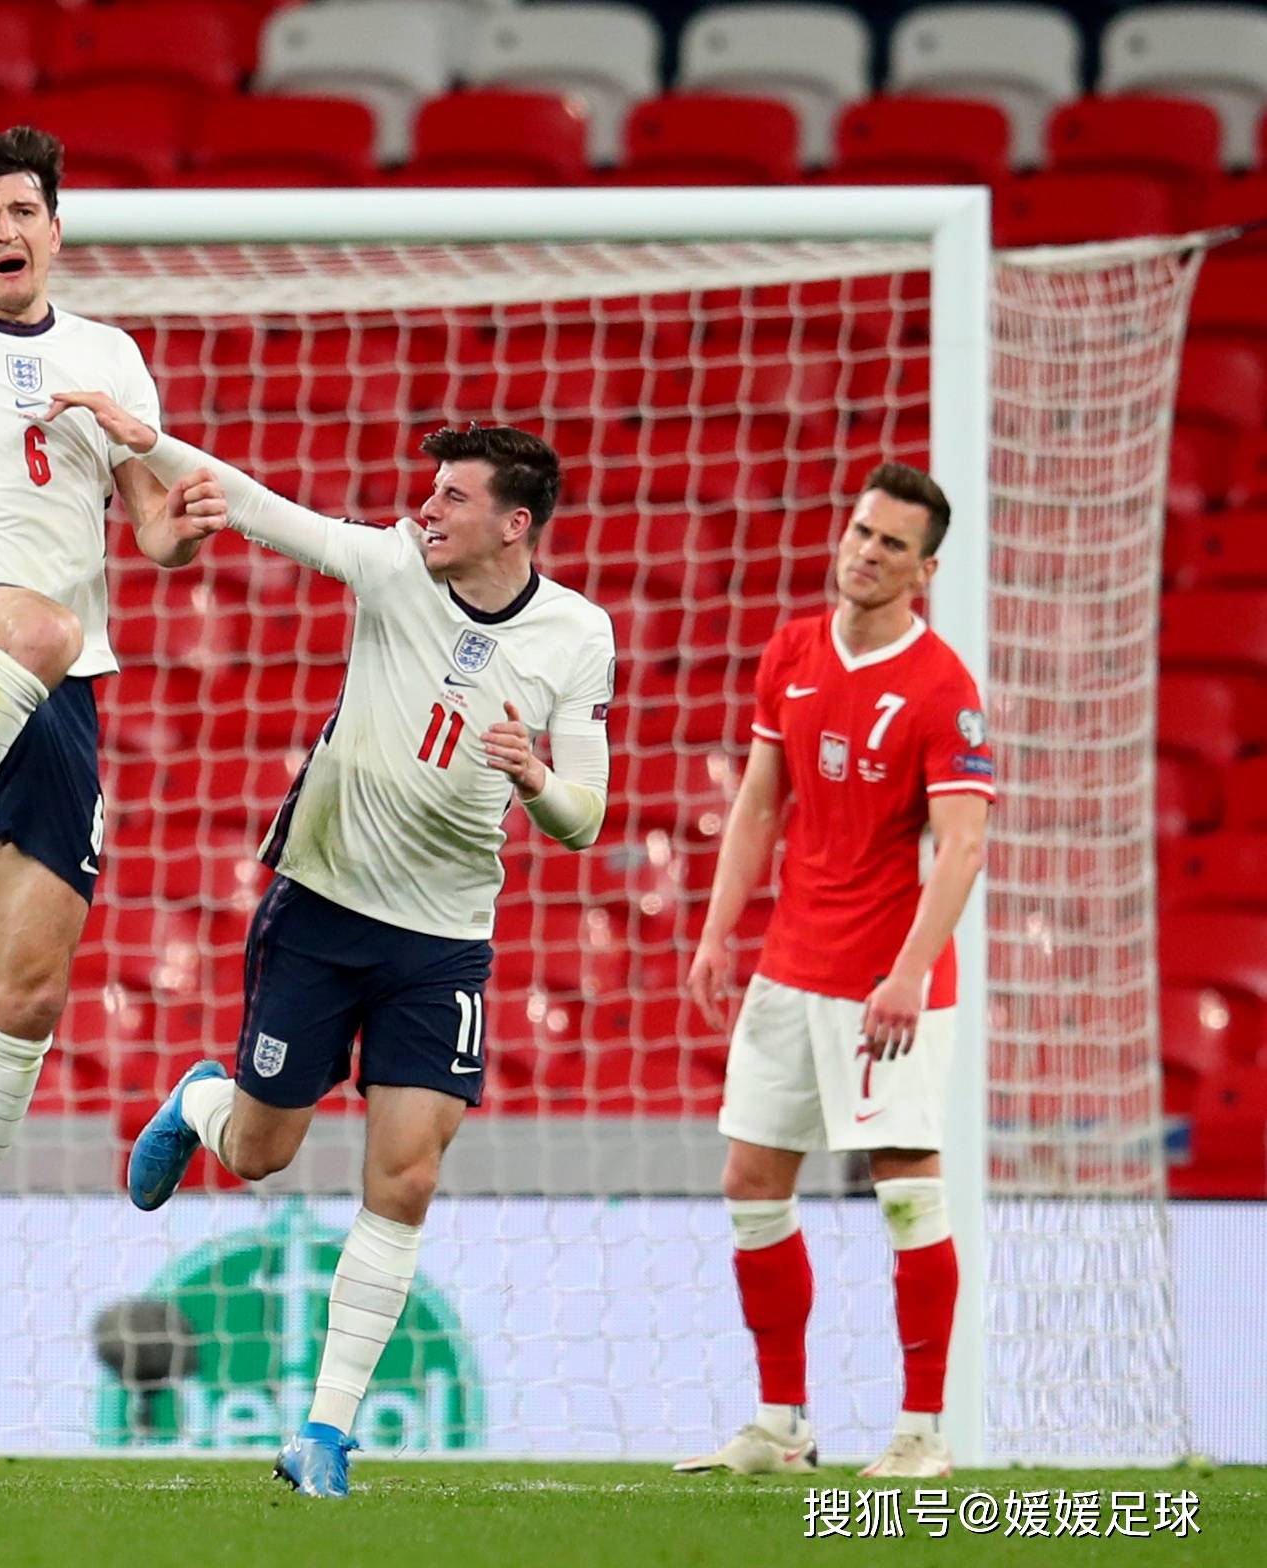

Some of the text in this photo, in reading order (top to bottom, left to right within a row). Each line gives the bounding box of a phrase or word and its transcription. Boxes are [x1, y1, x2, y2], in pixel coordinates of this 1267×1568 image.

[24, 425, 52, 487] 6
[417, 702, 465, 770] 11
[867, 692, 907, 750] 7
[455, 990, 482, 1057] 11
[854, 1043, 879, 1099] 7
